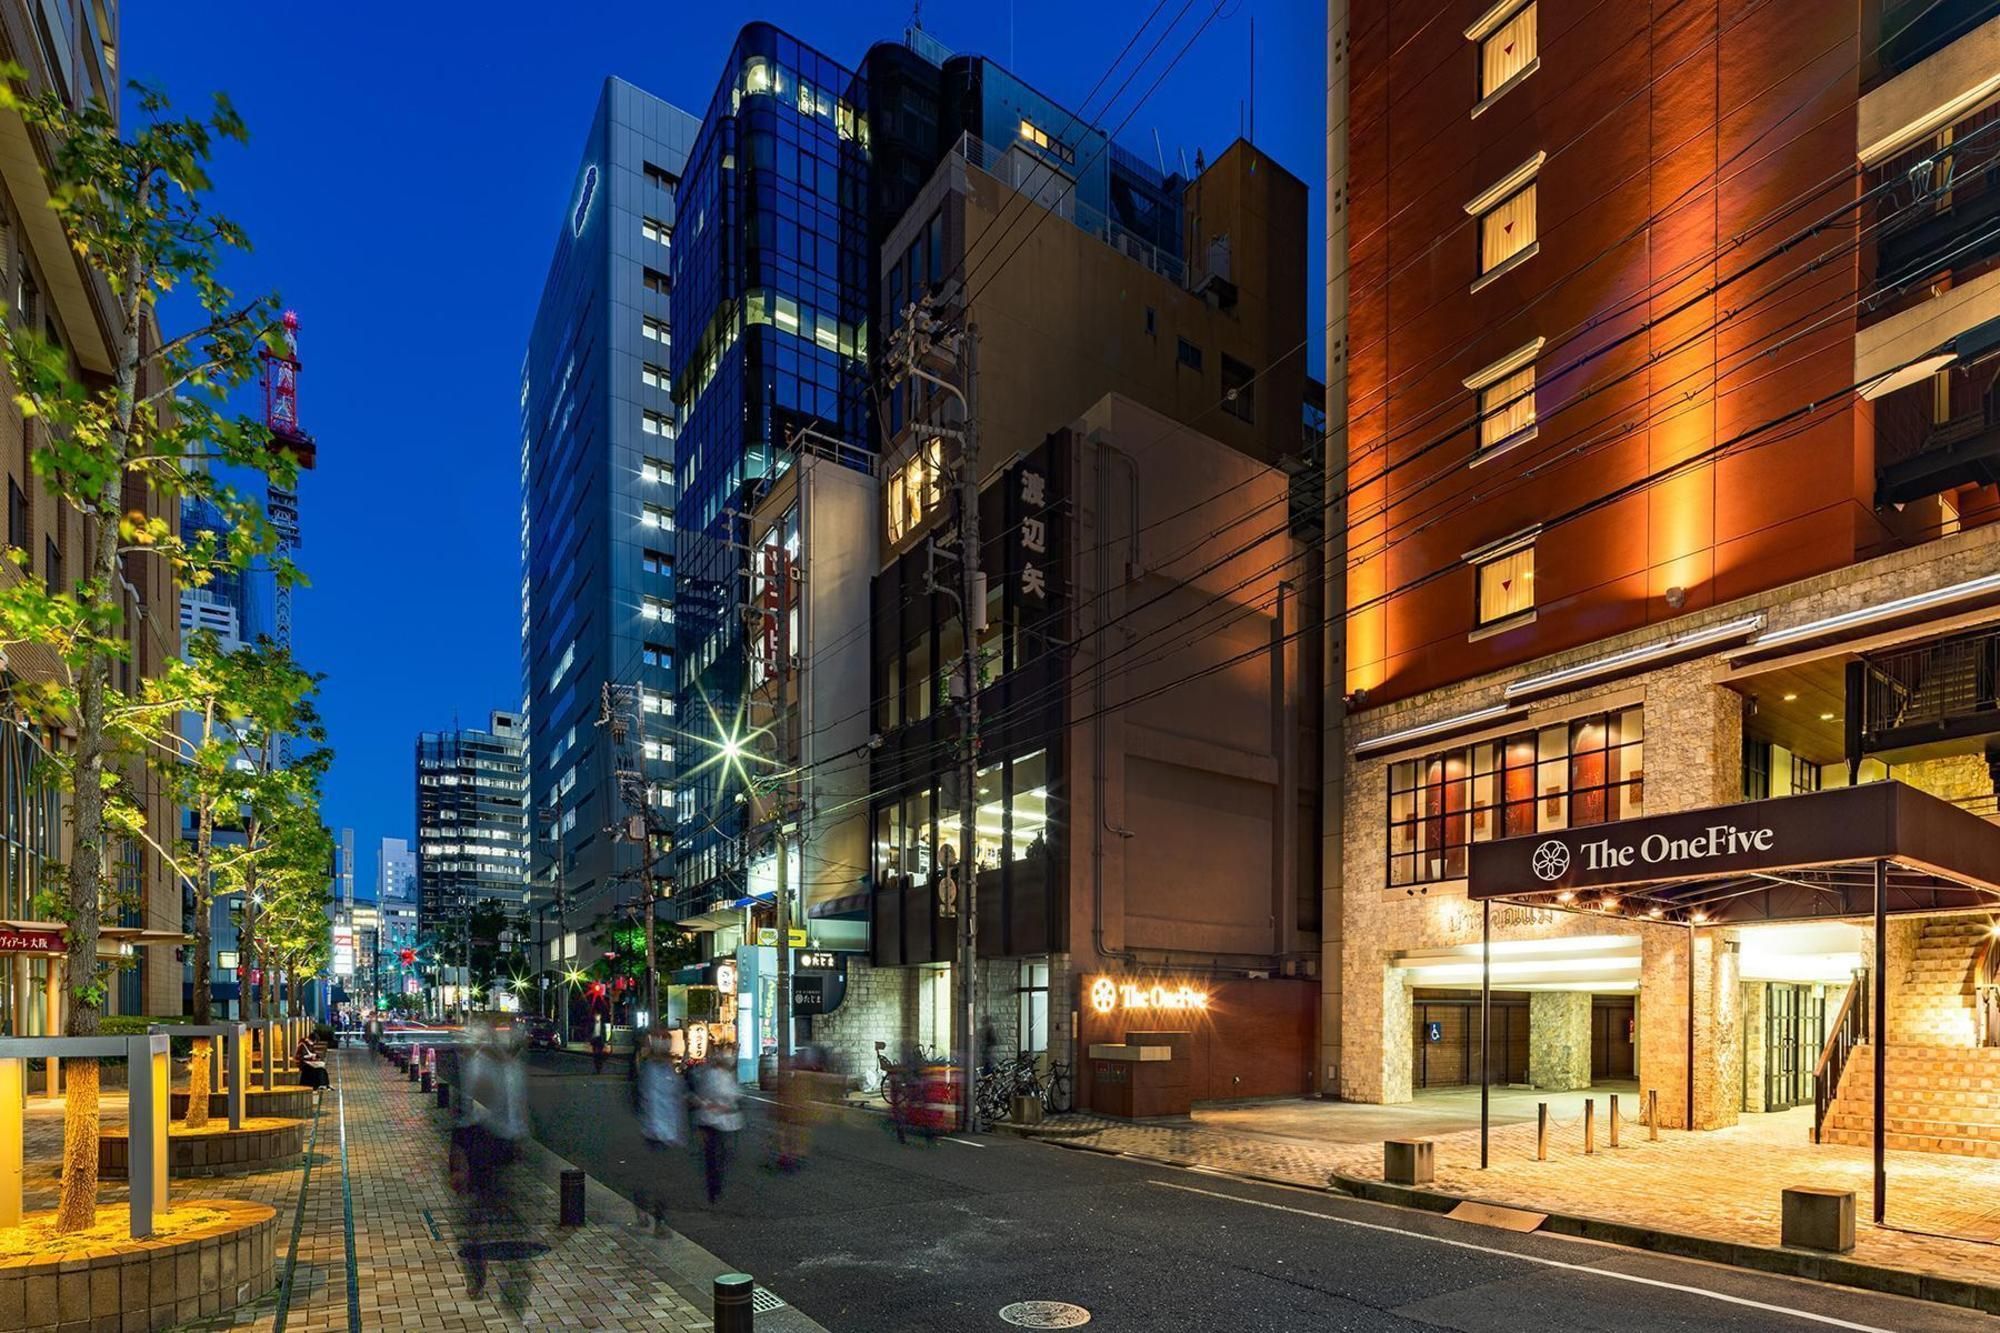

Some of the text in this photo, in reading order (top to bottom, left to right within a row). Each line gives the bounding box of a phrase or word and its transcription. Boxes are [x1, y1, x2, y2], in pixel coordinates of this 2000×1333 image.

[1580, 825, 1774, 871] The OneFive
[1119, 985, 1208, 1008] The OneFive
